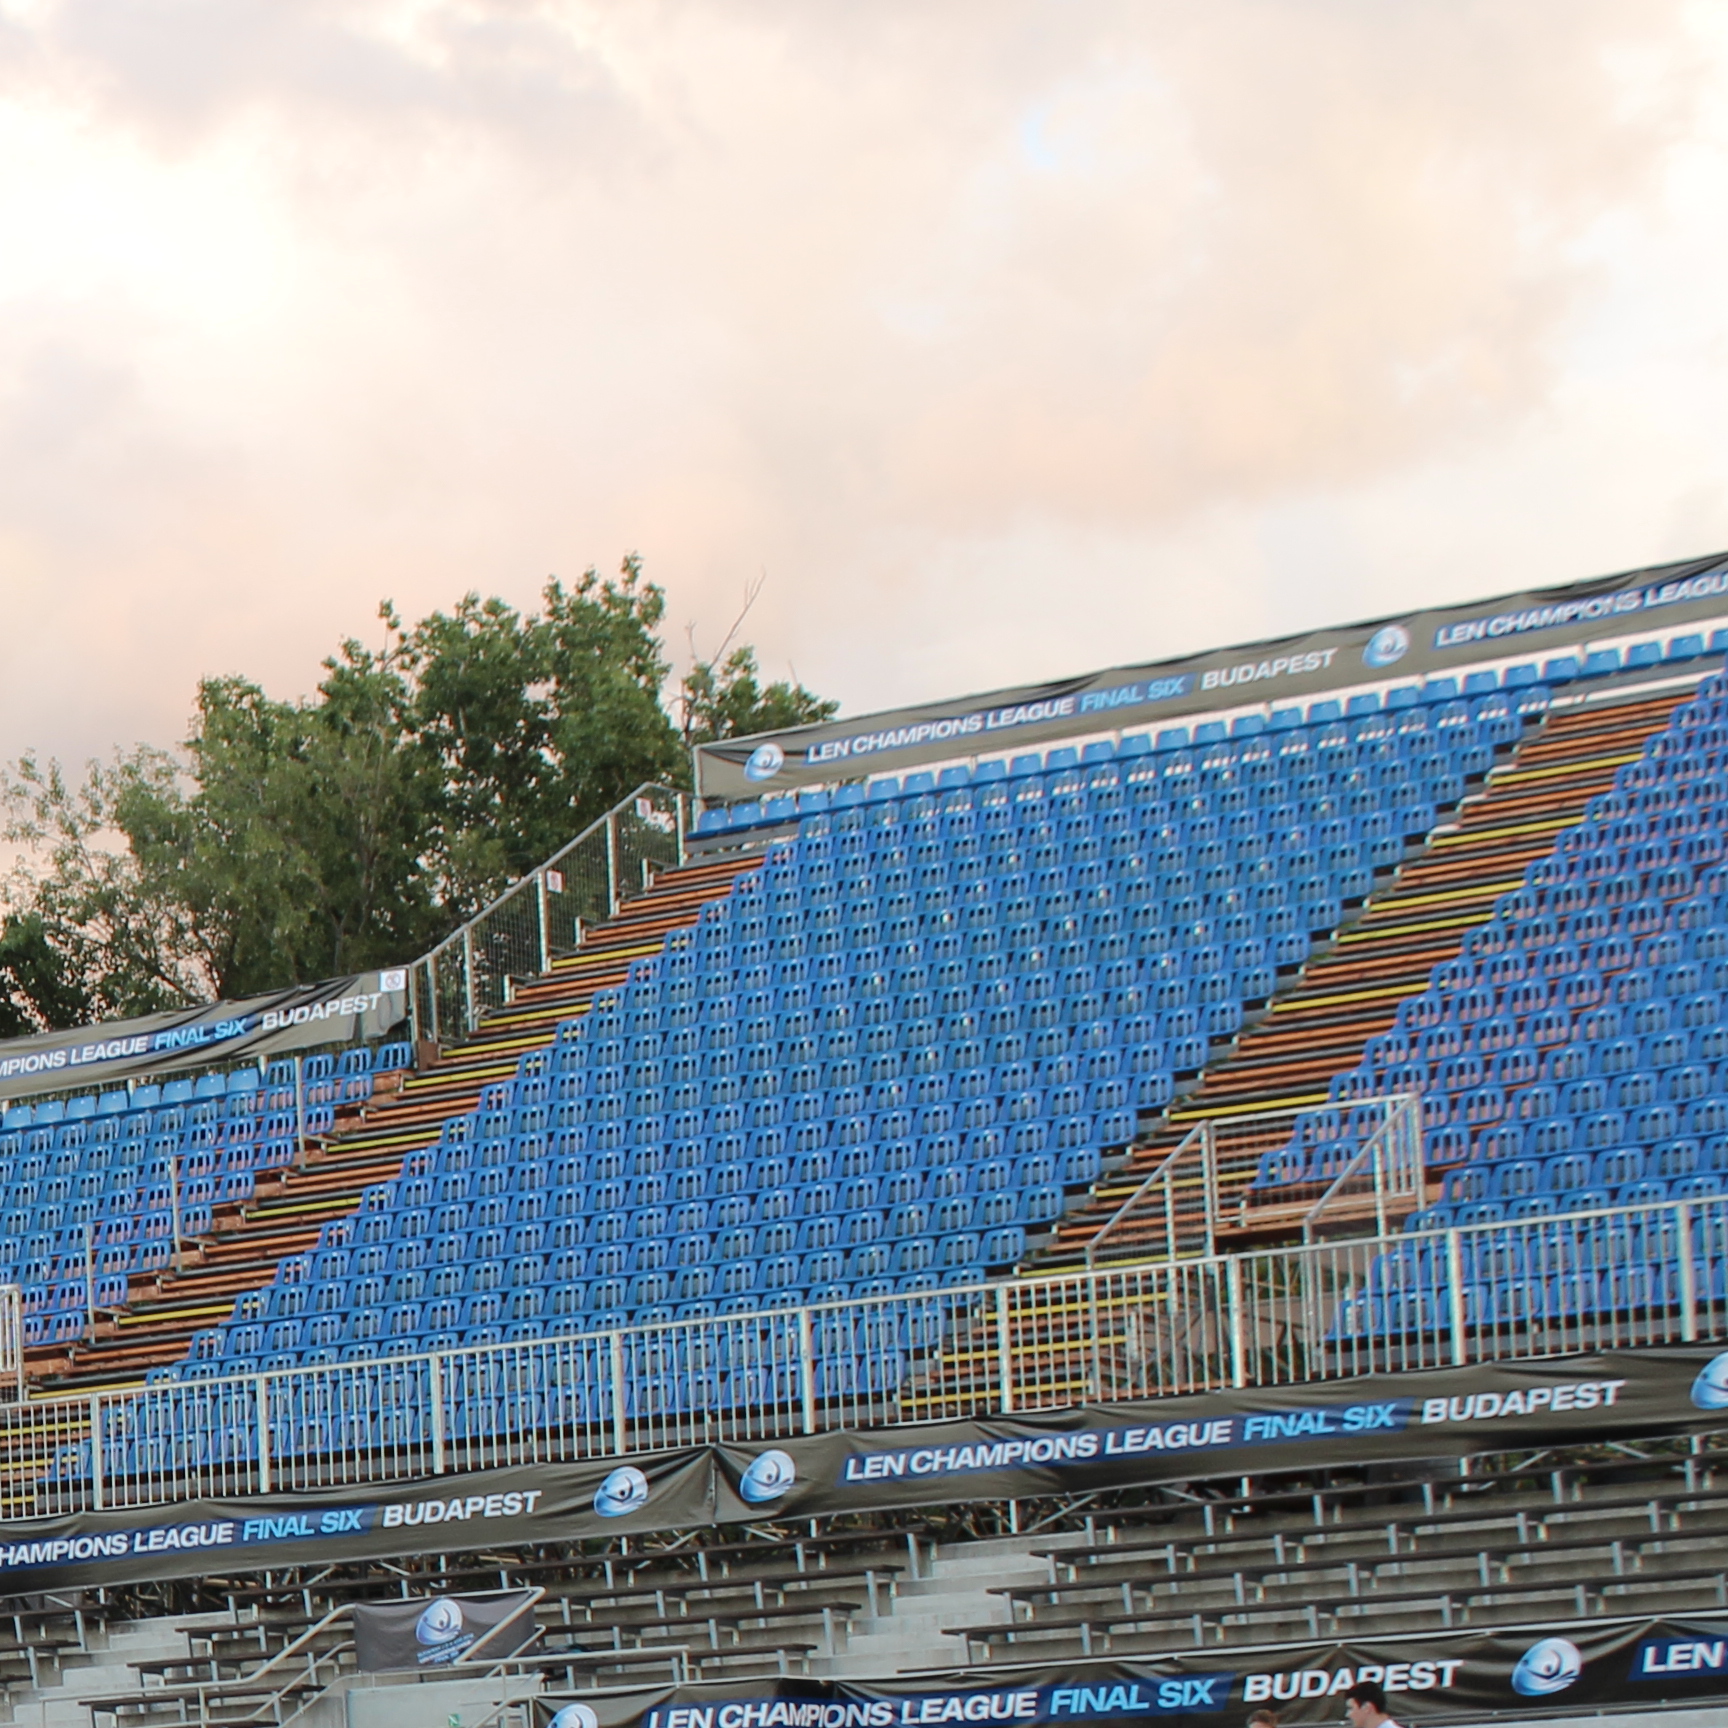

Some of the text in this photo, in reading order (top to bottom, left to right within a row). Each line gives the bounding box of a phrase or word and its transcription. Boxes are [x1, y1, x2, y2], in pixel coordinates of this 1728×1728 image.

[1436, 573, 1728, 648] LEN CHAMPIONS LEAGU
[808, 648, 1338, 765] LEN CHAMPIONS LEAGUE FINAL SIX BUDAPEST
[69, 1035, 148, 1066] LEAGUE
[154, 1022, 213, 1052] FINAL
[215, 1016, 246, 1042] SIX
[261, 992, 382, 1031] BUDAPEST
[845, 1379, 1627, 1482] LEN CHAMPIONS LEAGUE FINAL SIX BUDAPEST
[132, 1521, 233, 1554] LEAGUE
[242, 1513, 315, 1542] FINAL
[319, 1508, 363, 1535] SIX
[381, 1490, 542, 1529] BUDAPEST
[899, 1691, 1037, 1726] LEAGUE
[1049, 1684, 1146, 1717] FINAL
[1158, 1677, 1216, 1707] SIX
[1244, 1659, 1464, 1702] BUDAPEST
[1642, 1641, 1725, 1673] LEN
